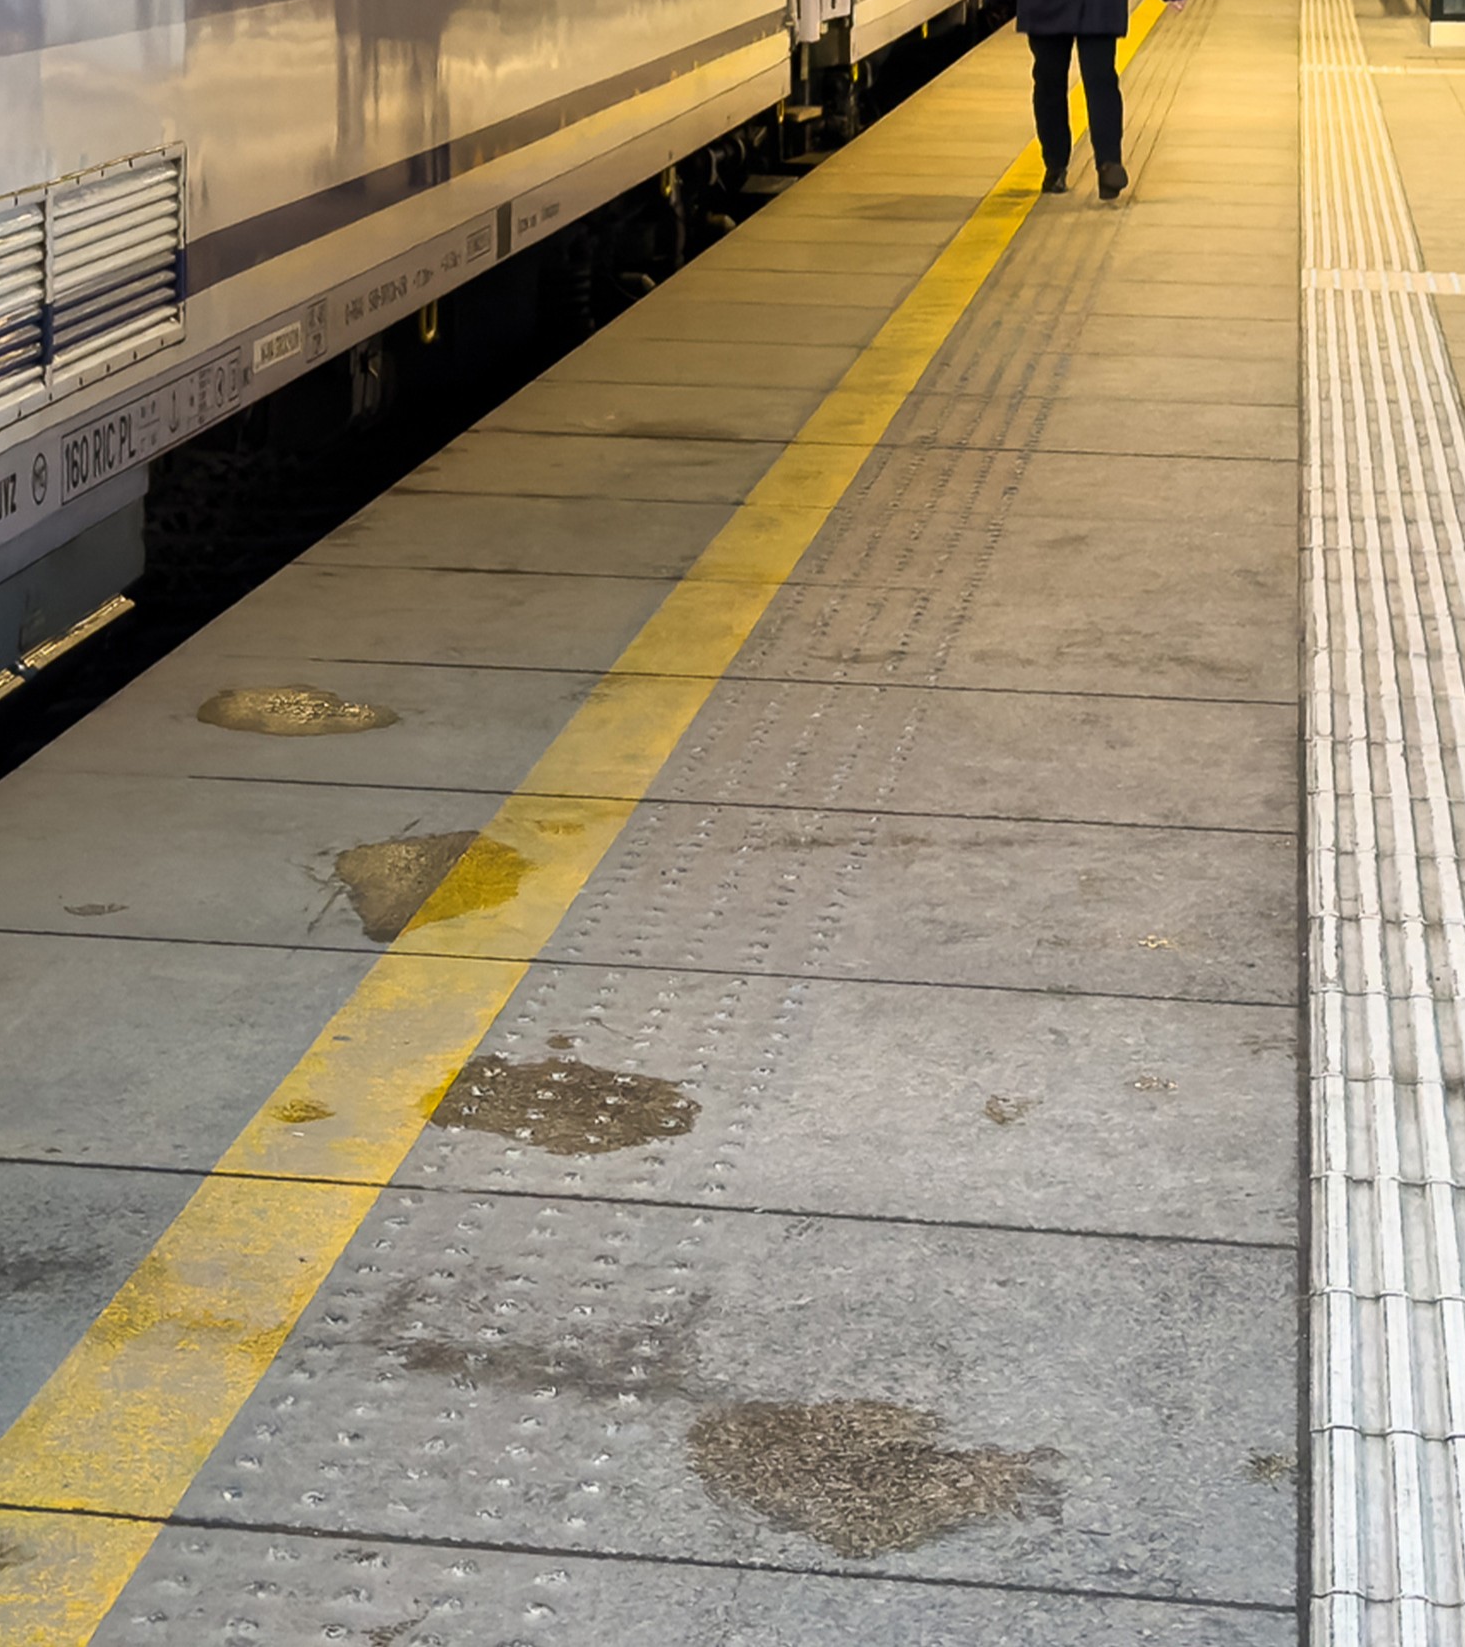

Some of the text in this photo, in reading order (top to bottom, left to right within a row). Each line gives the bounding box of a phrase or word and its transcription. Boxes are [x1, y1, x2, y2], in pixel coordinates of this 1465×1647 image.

[64, 435, 91, 494] 160
[93, 422, 116, 479] RIC
[119, 413, 137, 465] PL
